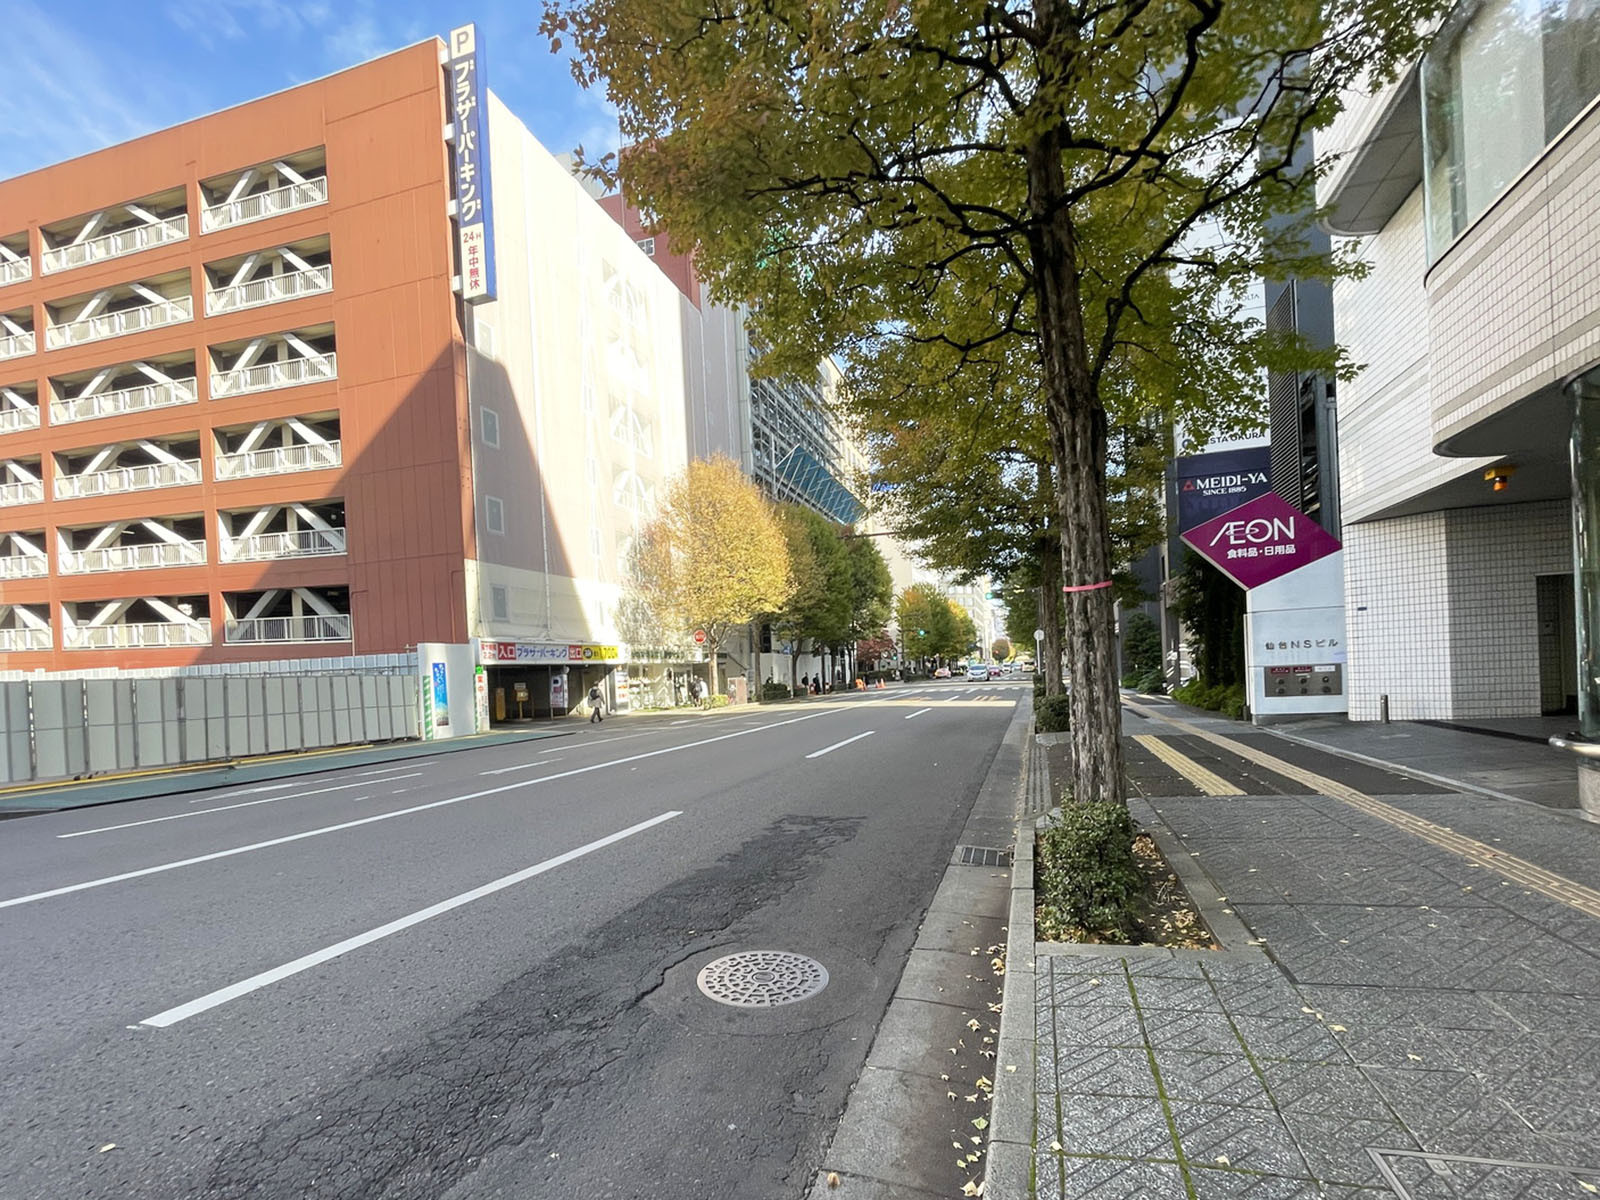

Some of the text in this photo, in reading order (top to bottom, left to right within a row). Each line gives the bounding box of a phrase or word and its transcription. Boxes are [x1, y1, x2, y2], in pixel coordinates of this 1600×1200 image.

[457, 31, 469, 53] P
[455, 59, 481, 222] ブラザーパーキング
[463, 231, 482, 244] 24H
[467, 245, 481, 290] 年中無休
[1196, 472, 1268, 490] MEIDI-YA
[1202, 485, 1247, 497] SINCE 1885
[1226, 544, 1296, 559] 食料品・日用品
[499, 645, 515, 659] 入口
[569, 647, 582, 659] 出口
